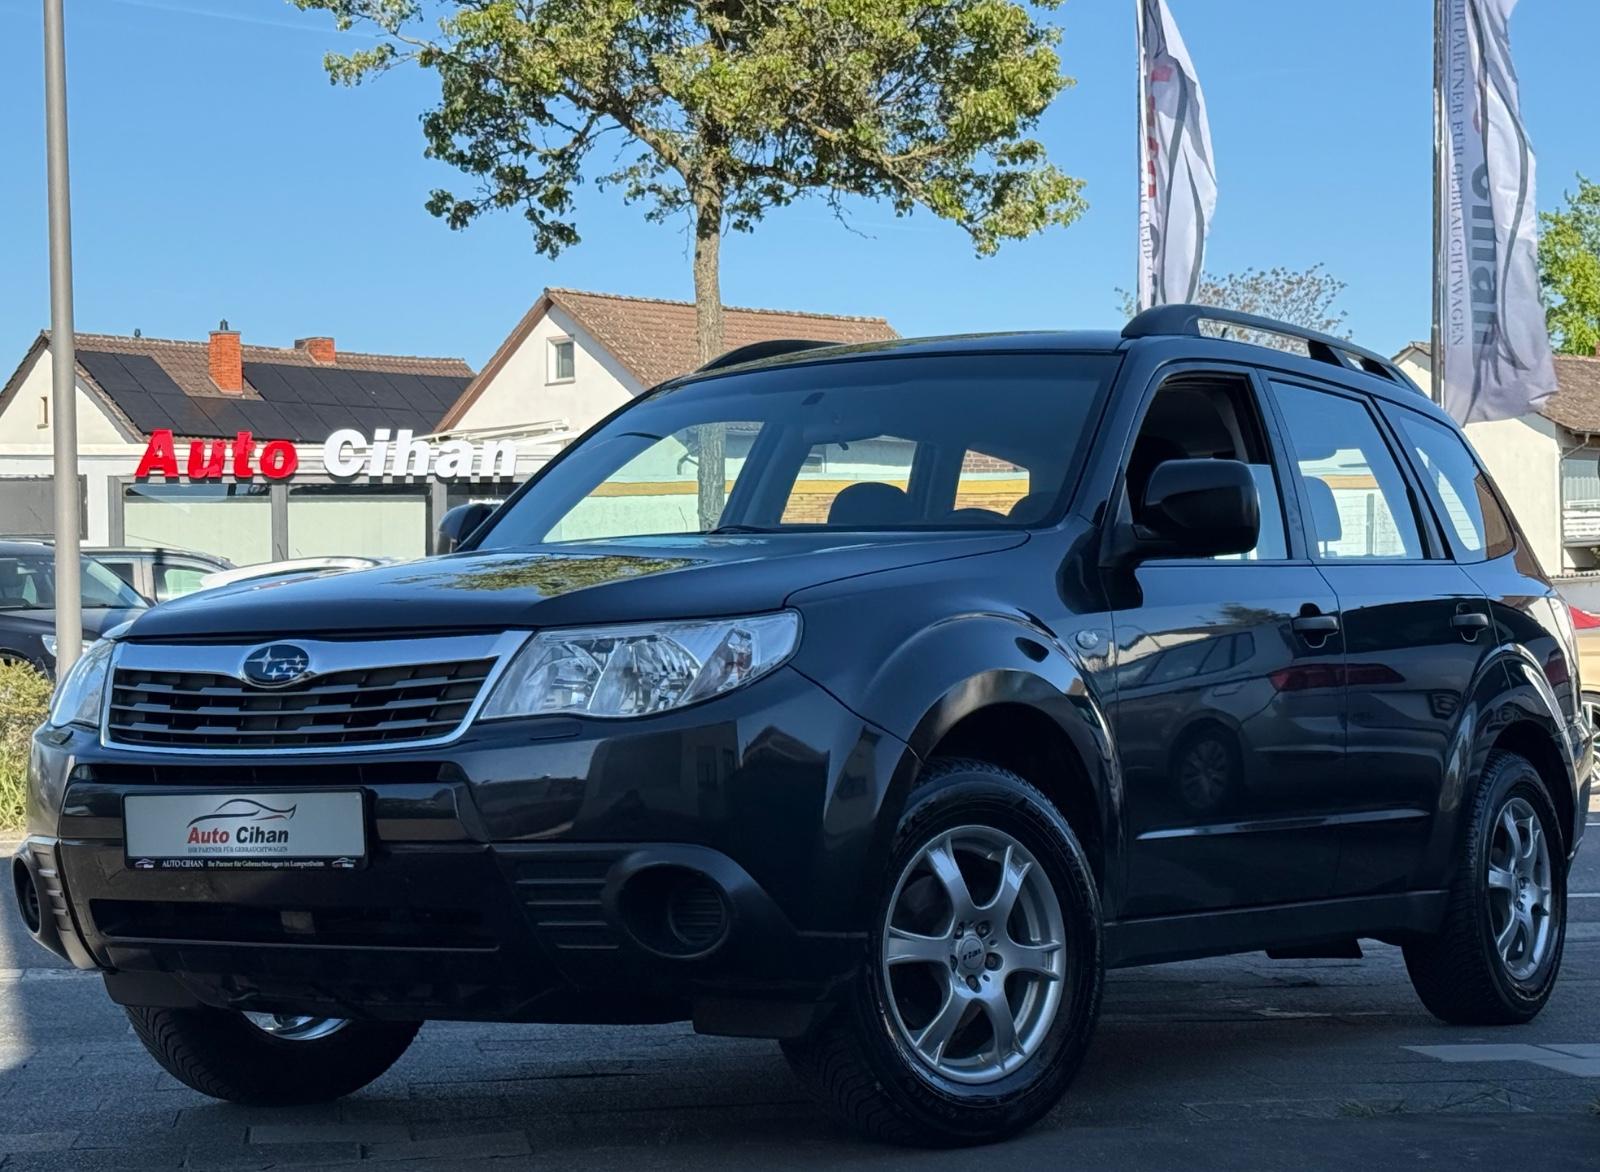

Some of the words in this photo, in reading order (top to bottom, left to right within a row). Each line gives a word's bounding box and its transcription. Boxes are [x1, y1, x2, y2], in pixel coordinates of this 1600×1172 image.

[1452, 28, 1466, 114] PARTNER
[1450, 162, 1465, 346] GEBRAUCHTWAGEN
[135, 428, 298, 479] Auto
[322, 427, 518, 478] Cihan
[187, 826, 230, 844] Auto
[236, 826, 289, 844] Cihan
[162, 859, 180, 868] AUTO
